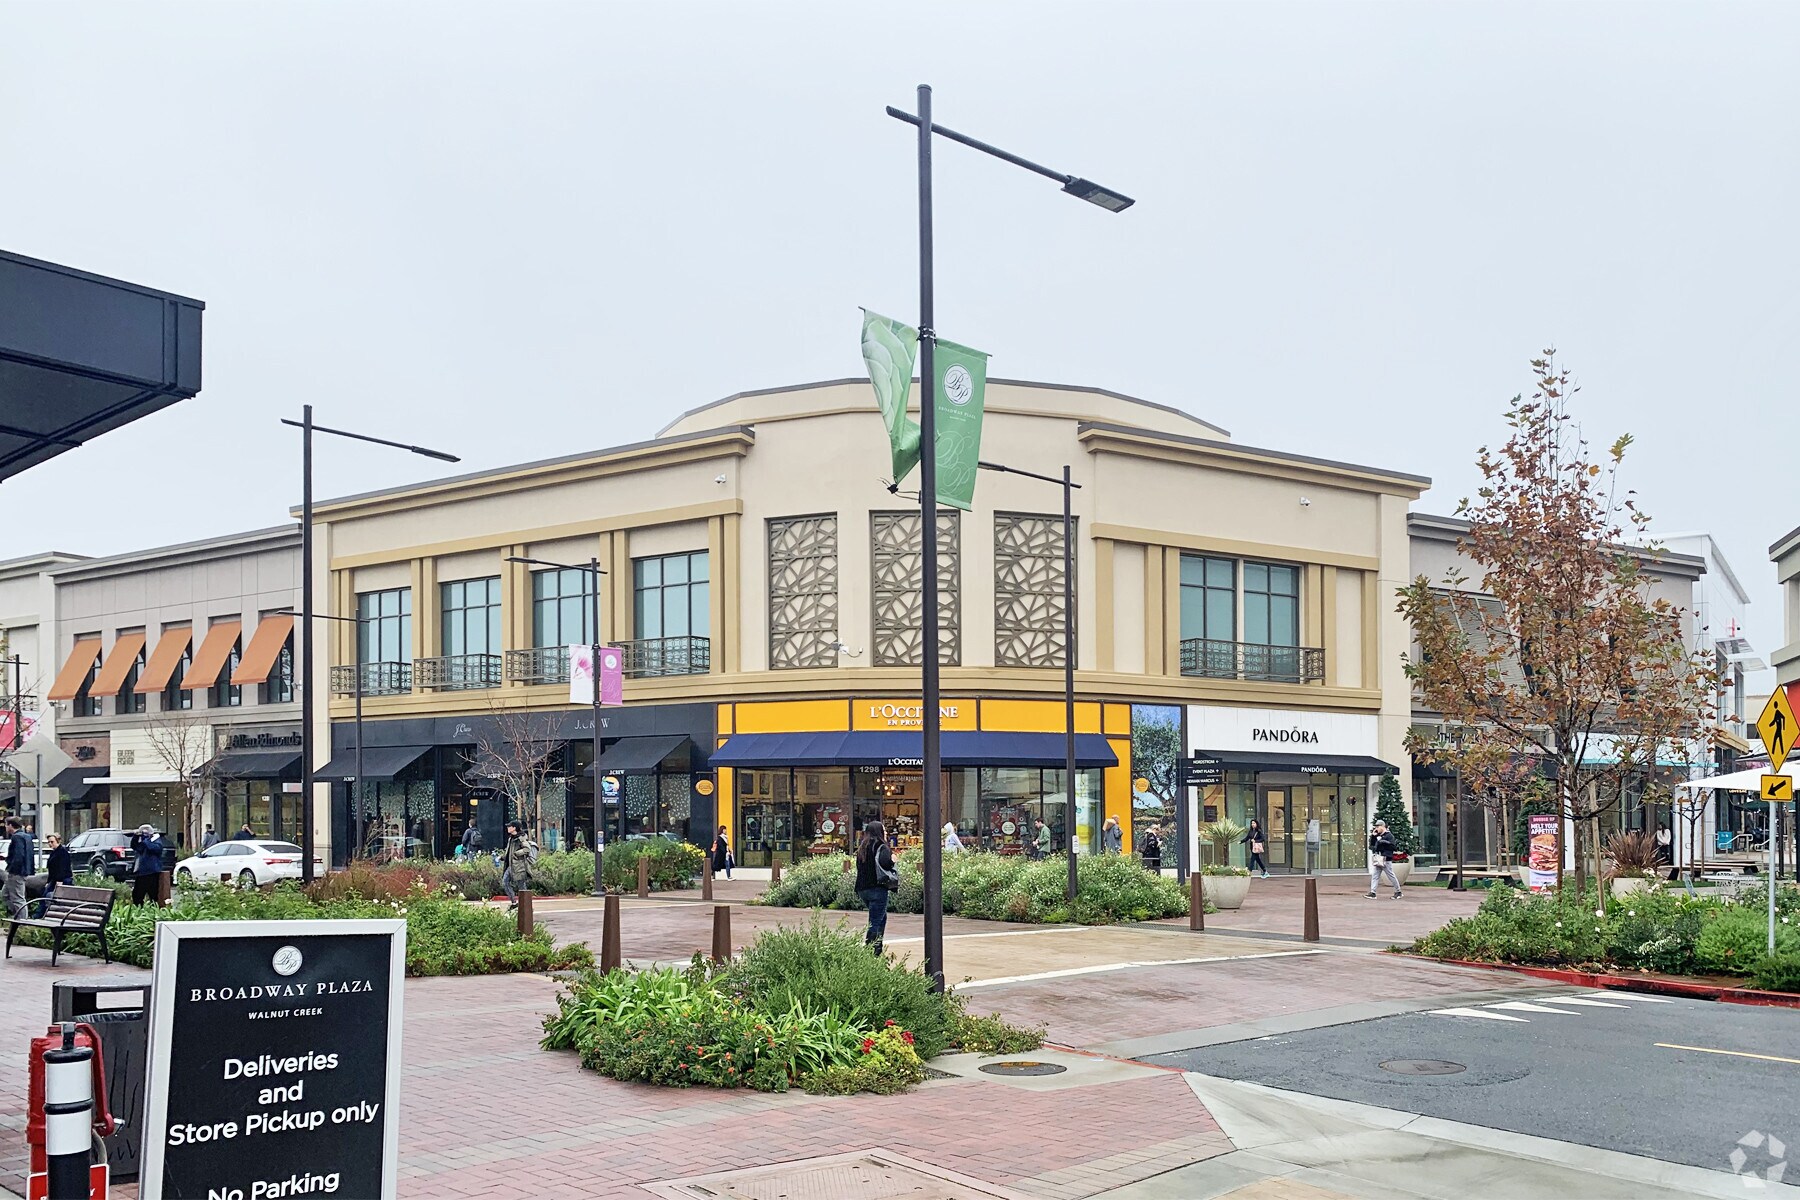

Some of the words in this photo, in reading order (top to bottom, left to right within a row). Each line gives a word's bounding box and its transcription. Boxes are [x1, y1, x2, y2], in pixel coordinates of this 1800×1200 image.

[870, 703, 959, 718] L'OCCINE
[574, 717, 610, 730] J.CRW
[887, 719, 898, 727] EN
[1252, 726, 1319, 743] PANDORA
[888, 758, 924, 766] L'OCCITAN
[190, 983, 308, 1002] BROADWAY
[316, 980, 373, 995] PLAZA
[248, 1009, 290, 1020] WALNUT
[293, 1007, 323, 1018] CREEK
[223, 1051, 339, 1080] Deliveries
[258, 1080, 304, 1105] and
[168, 1121, 238, 1146] Store
[245, 1110, 325, 1136] Pickup
[331, 1100, 380, 1123] only
[208, 1186, 243, 1200] No
[251, 1172, 340, 1200] Parking
